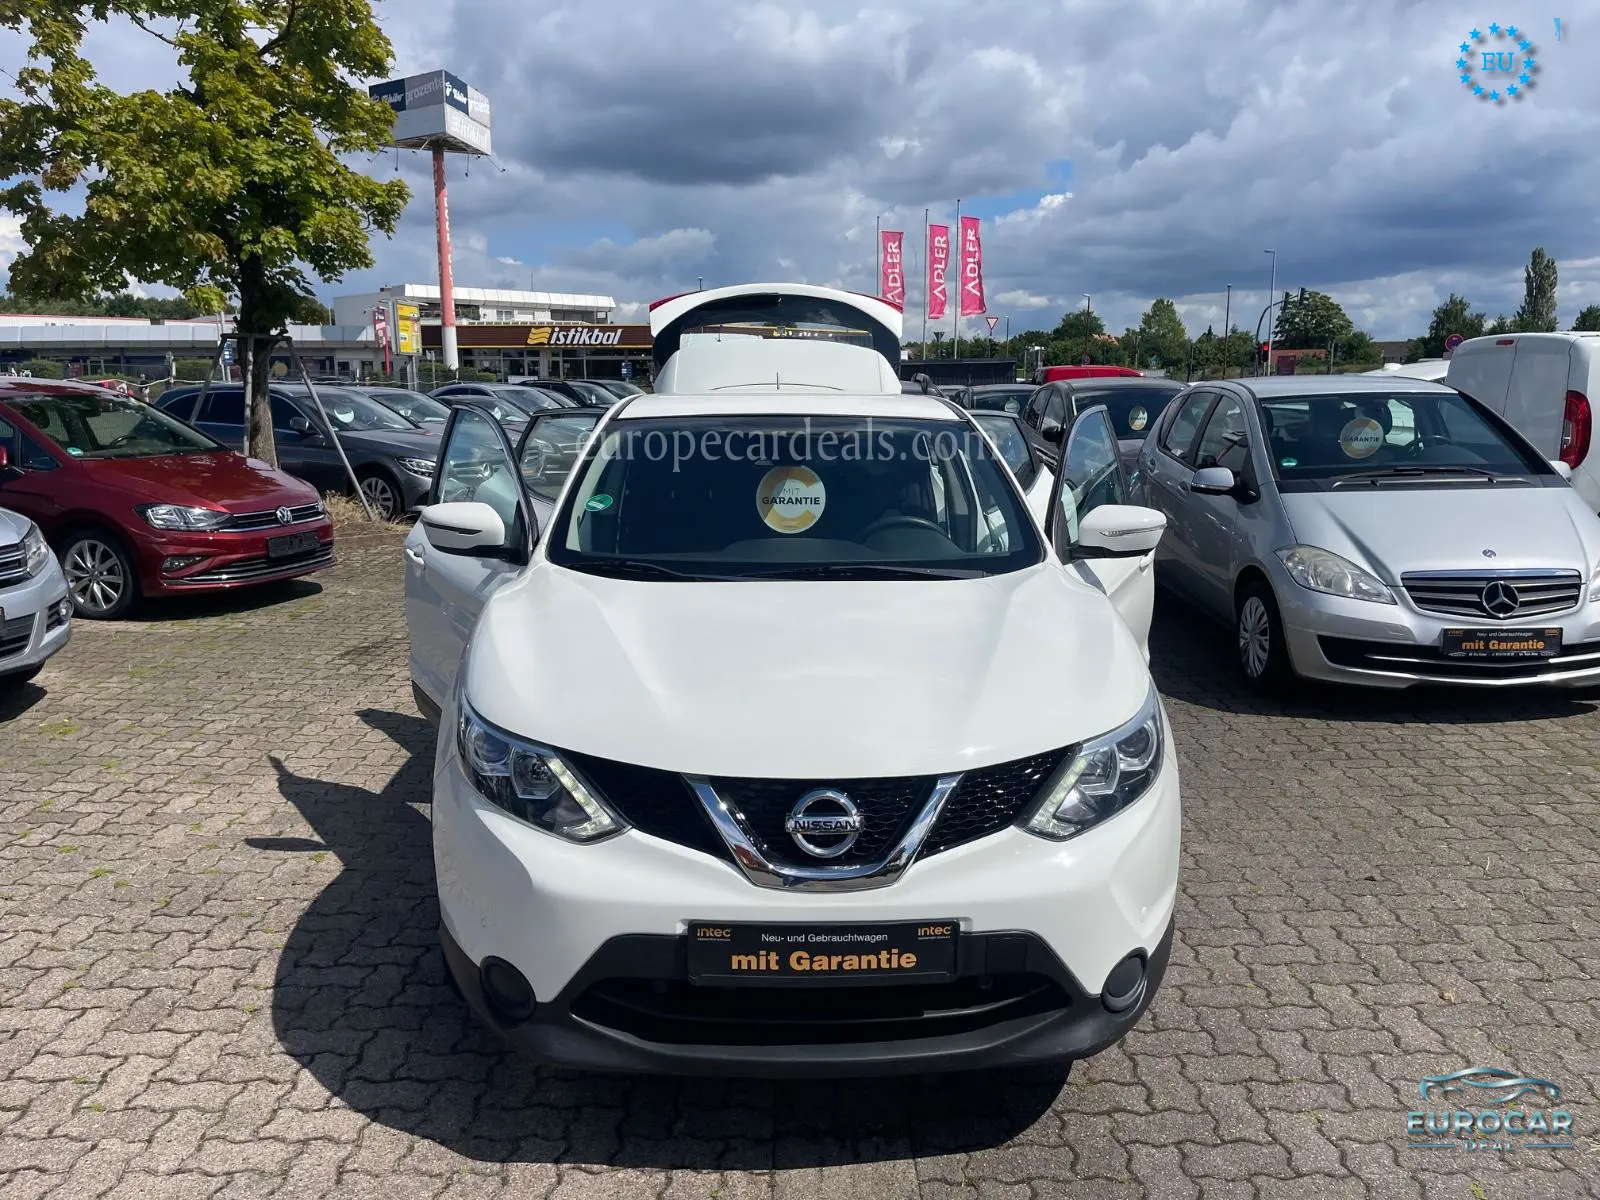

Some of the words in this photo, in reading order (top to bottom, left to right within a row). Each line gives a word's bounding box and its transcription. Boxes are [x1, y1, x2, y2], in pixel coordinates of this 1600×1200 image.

[965, 228, 980, 296] ADLER
[886, 241, 901, 303] ADLER
[933, 235, 947, 301] ADLER
[550, 326, 624, 345] istikbal
[783, 487, 800, 496] MIT
[761, 496, 820, 505] GARANTIE
[1462, 640, 1485, 650] mit
[1489, 639, 1545, 650] Garantie
[794, 820, 856, 830] NISSAN
[697, 928, 731, 937] intec
[918, 926, 951, 936] intec
[762, 933, 784, 942] Neu-
[787, 934, 805, 942] und
[808, 933, 888, 944] Gebrauchtwagen
[731, 950, 779, 970] mit
[789, 948, 917, 971] Garantie
